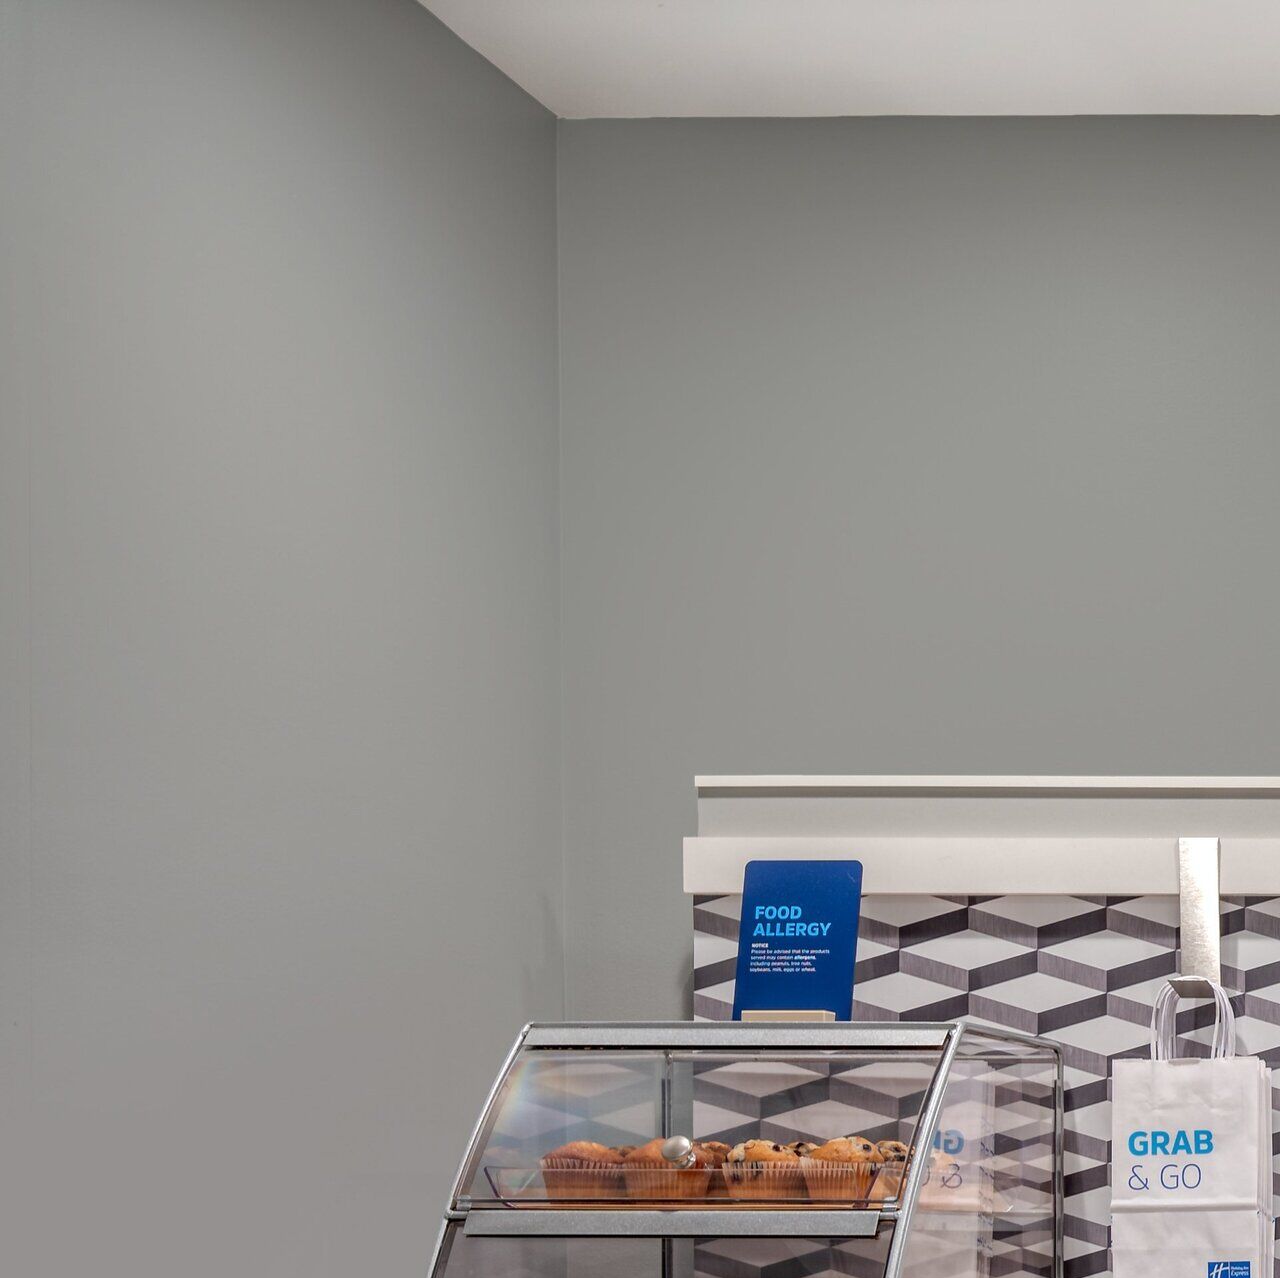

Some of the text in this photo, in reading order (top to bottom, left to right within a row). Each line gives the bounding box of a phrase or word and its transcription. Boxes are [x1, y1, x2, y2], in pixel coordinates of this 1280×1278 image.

[754, 905, 802, 920] FOOD
[752, 922, 832, 937] ALLERGY
[1127, 1129, 1214, 1157] GRAB
[1127, 1163, 1202, 1190] & GO
